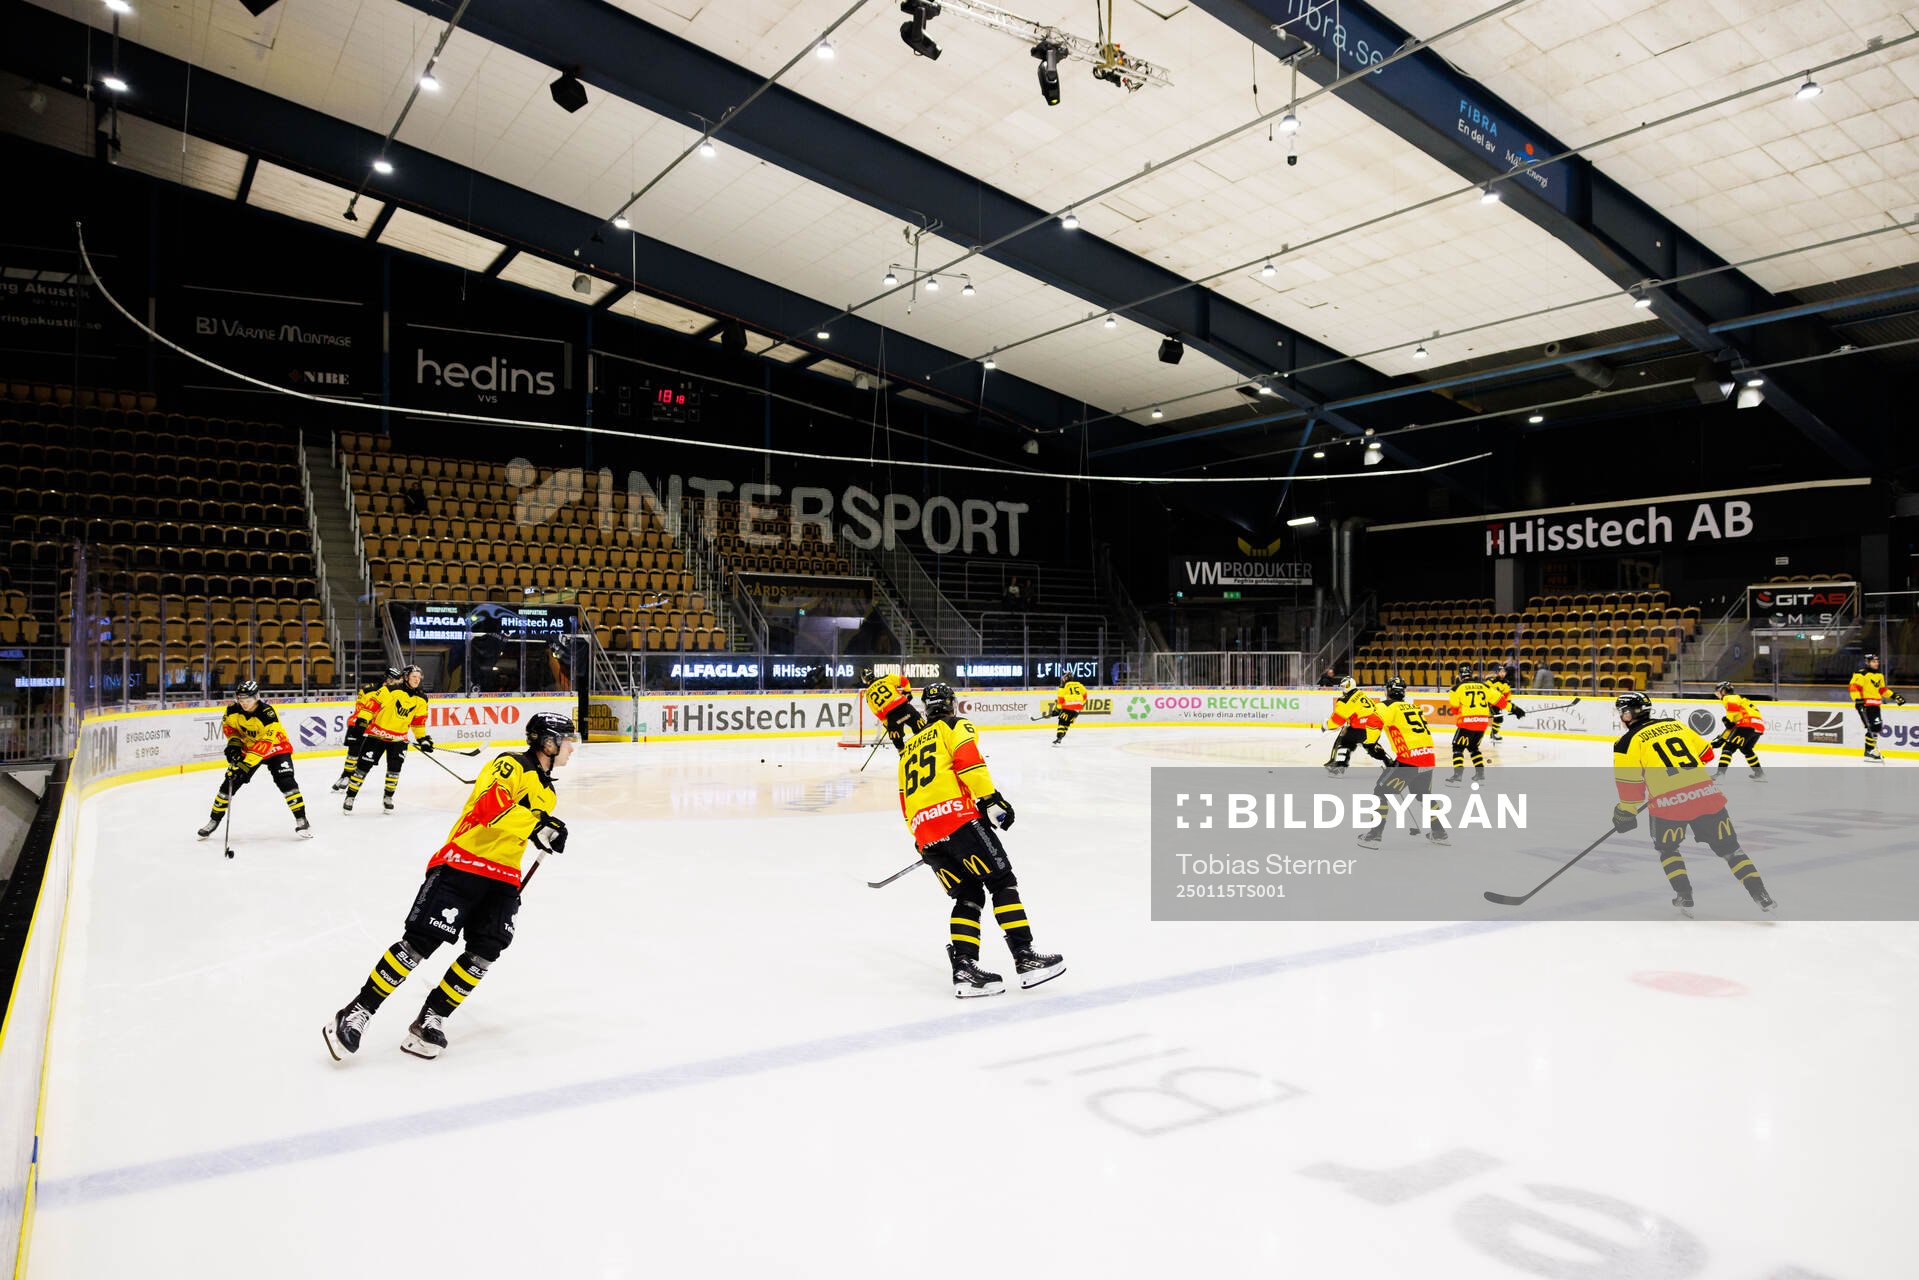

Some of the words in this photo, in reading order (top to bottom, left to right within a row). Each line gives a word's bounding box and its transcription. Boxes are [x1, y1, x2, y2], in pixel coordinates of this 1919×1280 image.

[1458, 99, 1498, 137] FIBRA
[1457, 118, 1470, 136] En
[1471, 129, 1485, 147] del
[1485, 142, 1496, 153] av
[195, 315, 218, 335] BJ
[278, 324, 352, 347] MONTAGE
[303, 371, 350, 385] NIBE
[416, 347, 556, 396] hedins
[657, 389, 672, 403] 18
[598, 466, 1030, 557] INTERSPORT
[1509, 507, 1673, 554] Hisstech
[1687, 500, 1754, 542] AB
[1222, 562, 1312, 578] PRODUKTER
[1775, 593, 1849, 606] GITAB
[507, 617, 548, 627] Hisstech
[549, 617, 564, 627] AB
[670, 664, 759, 678] ALFAGLAS
[836, 664, 855, 677] AB
[1037, 663, 1053, 678] LF
[1054, 662, 1098, 677] INVEST
[870, 685, 892, 707] 29
[1154, 696, 1202, 710] GOOD
[1207, 697, 1300, 710] RECYCLING
[1464, 690, 1487, 709] 73
[974, 702, 1028, 712] Raumaster
[1183, 711, 1192, 719] Vi
[1216, 711, 1234, 719] dina
[1235, 711, 1269, 719] metaller
[431, 705, 520, 727] IKANO
[683, 703, 806, 731] Hisstech
[815, 701, 854, 728] AB
[1536, 716, 1568, 731] RÖR
[457, 729, 492, 740] Bostad
[1638, 723, 1684, 743] JOHANSSON
[141, 747, 160, 758] BYGG
[1653, 737, 1698, 778] 19
[905, 742, 937, 799] 65
[429, 917, 457, 935] Telexia
